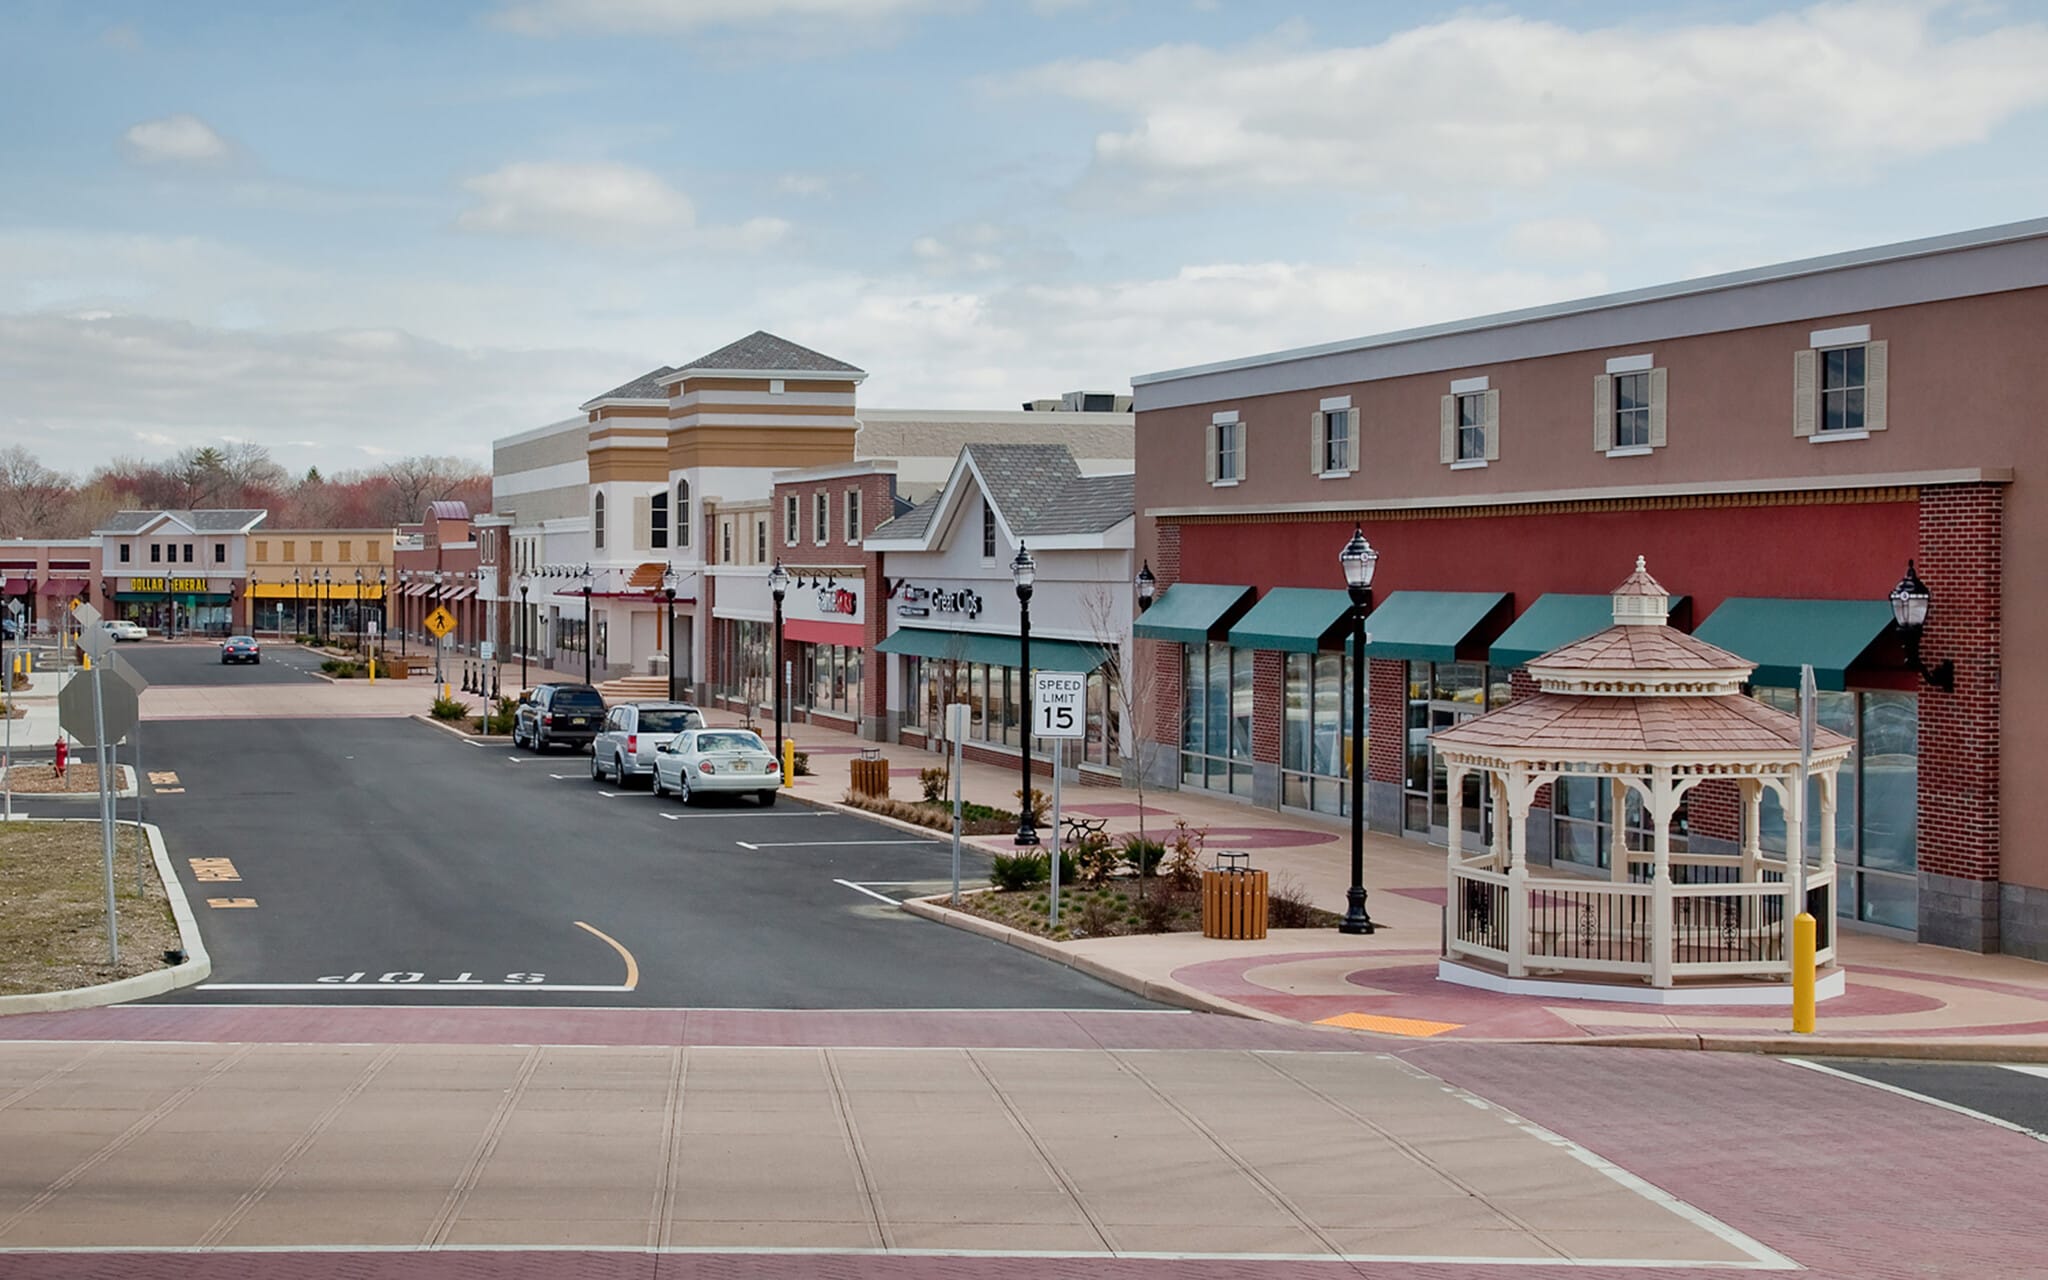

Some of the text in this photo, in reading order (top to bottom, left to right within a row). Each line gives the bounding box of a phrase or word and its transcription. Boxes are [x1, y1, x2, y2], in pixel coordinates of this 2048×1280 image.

[130, 577, 165, 592] DOLLAR
[932, 587, 957, 612] Great
[1039, 679, 1081, 691] SPEED
[1042, 693, 1076, 704] LIMIT
[1043, 706, 1074, 729] 15
[317, 972, 546, 983] STOP
